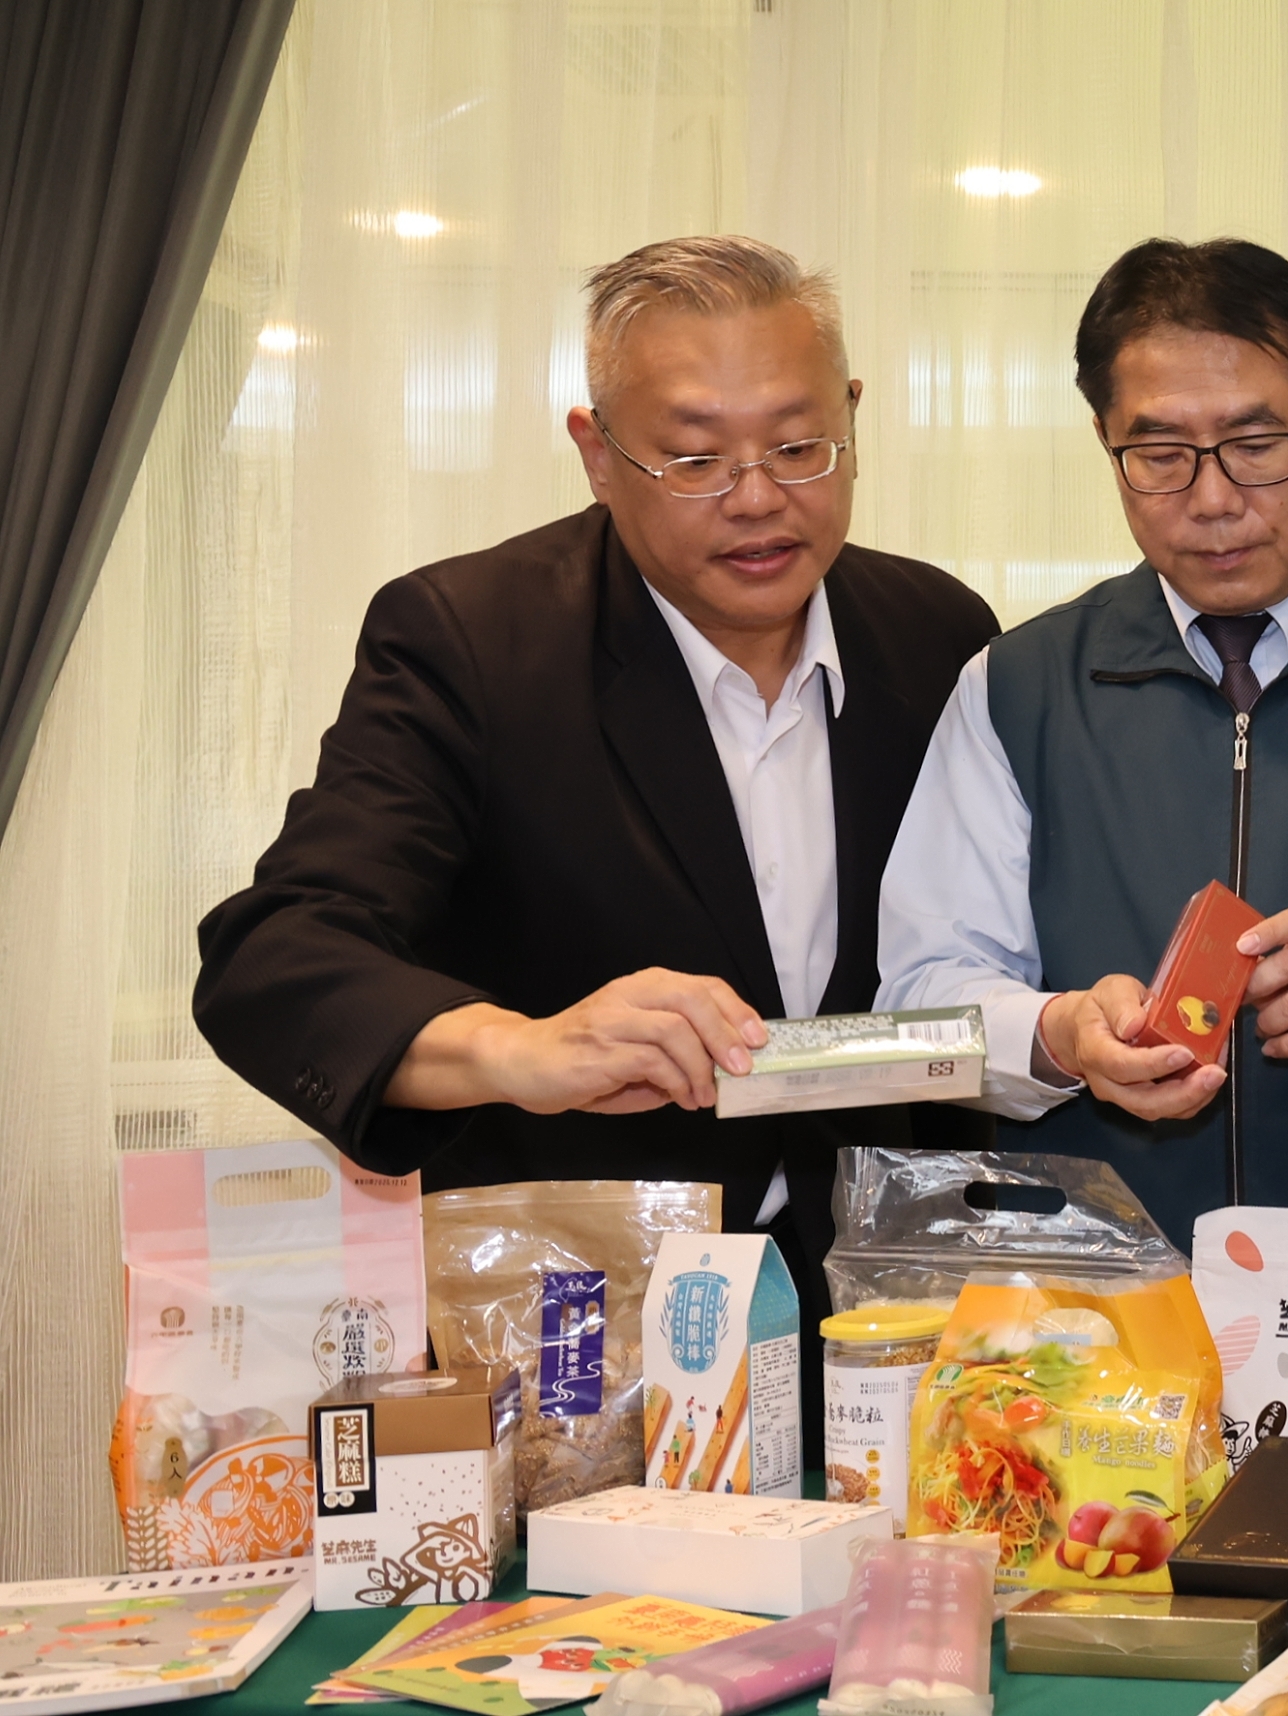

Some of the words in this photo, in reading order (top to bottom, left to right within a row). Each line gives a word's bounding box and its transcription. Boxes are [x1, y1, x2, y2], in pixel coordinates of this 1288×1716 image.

[337, 1416, 362, 1484] 芝麻糕
[1077, 1424, 1176, 1458] 養生芒果麵
[1093, 1454, 1122, 1467] Mango
[1124, 1458, 1157, 1469] noodles
[322, 1538, 377, 1557] 芝麻先生
